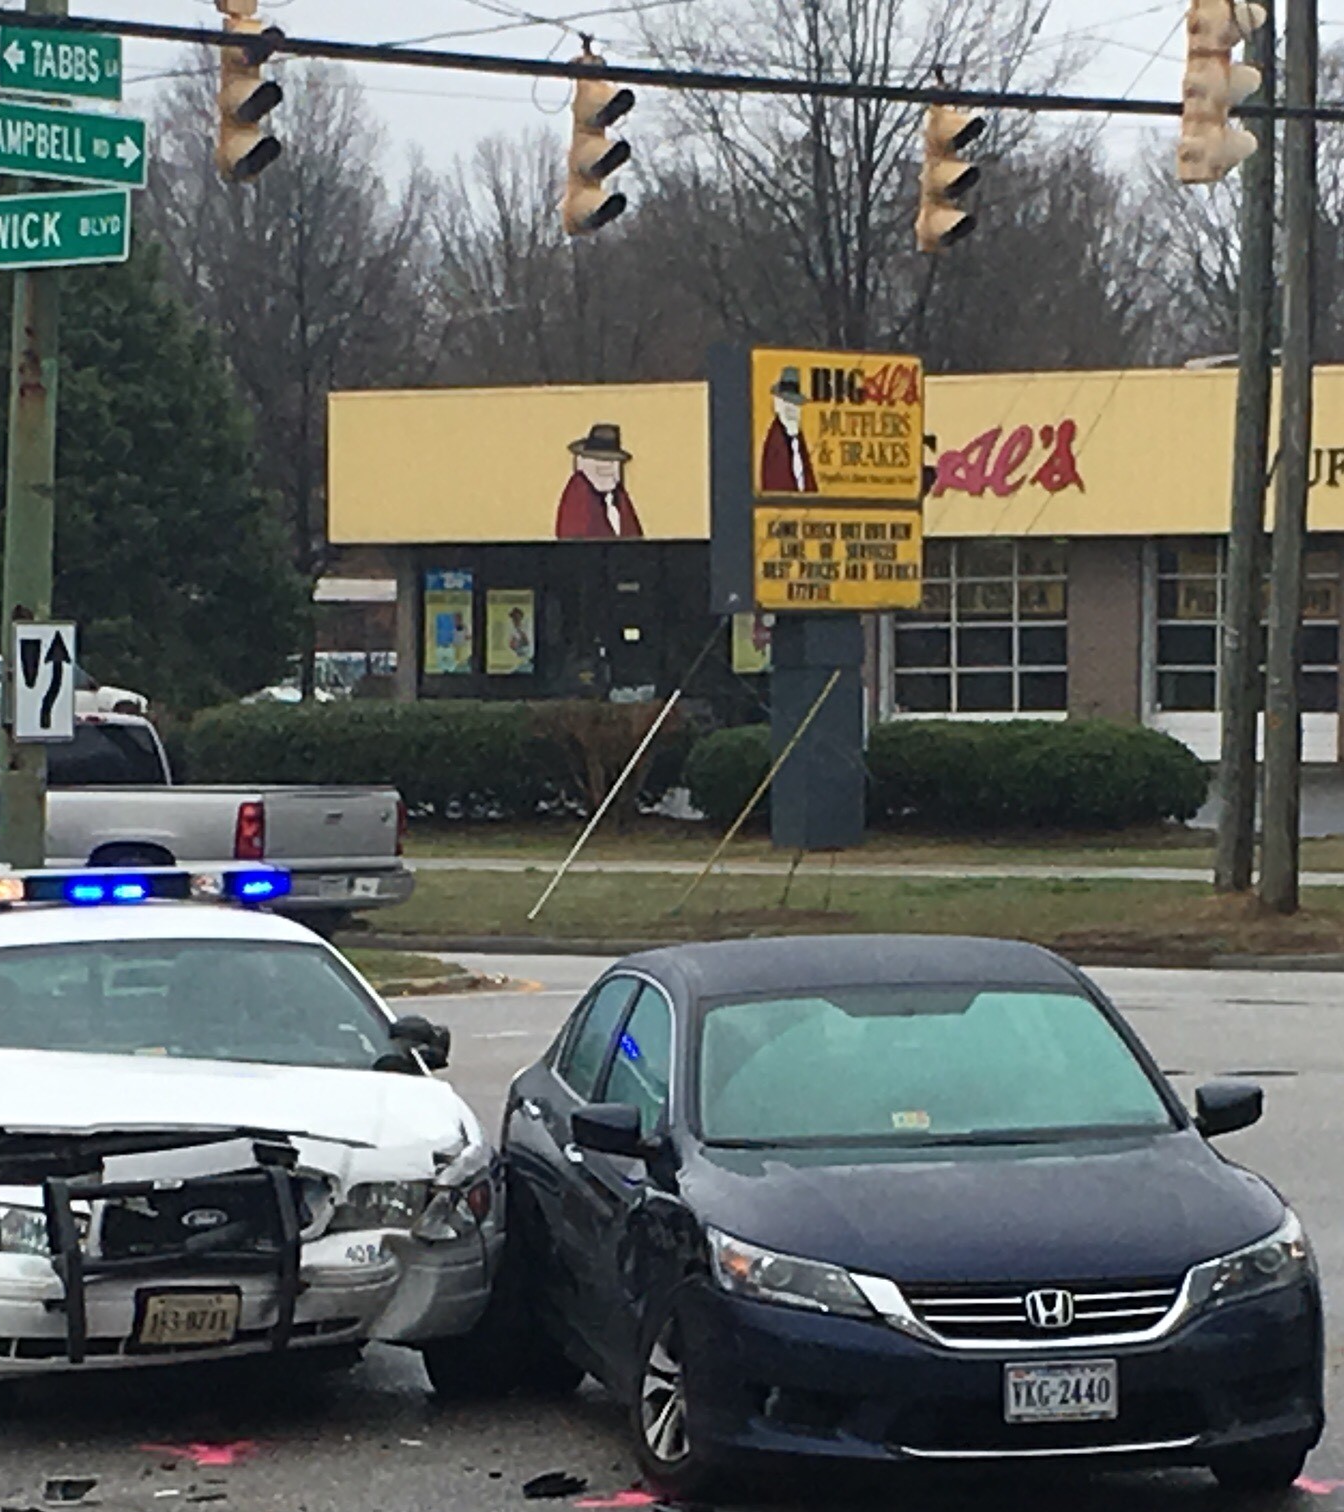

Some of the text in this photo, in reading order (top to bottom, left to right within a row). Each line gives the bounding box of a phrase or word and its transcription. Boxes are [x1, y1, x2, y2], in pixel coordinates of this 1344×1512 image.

[31, 40, 99, 83] TABBS
[79, 215, 121, 236] BLVD
[811, 367, 865, 406] BIG
[819, 410, 911, 438] MUFFLERS
[840, 440, 911, 468] BRAKES
